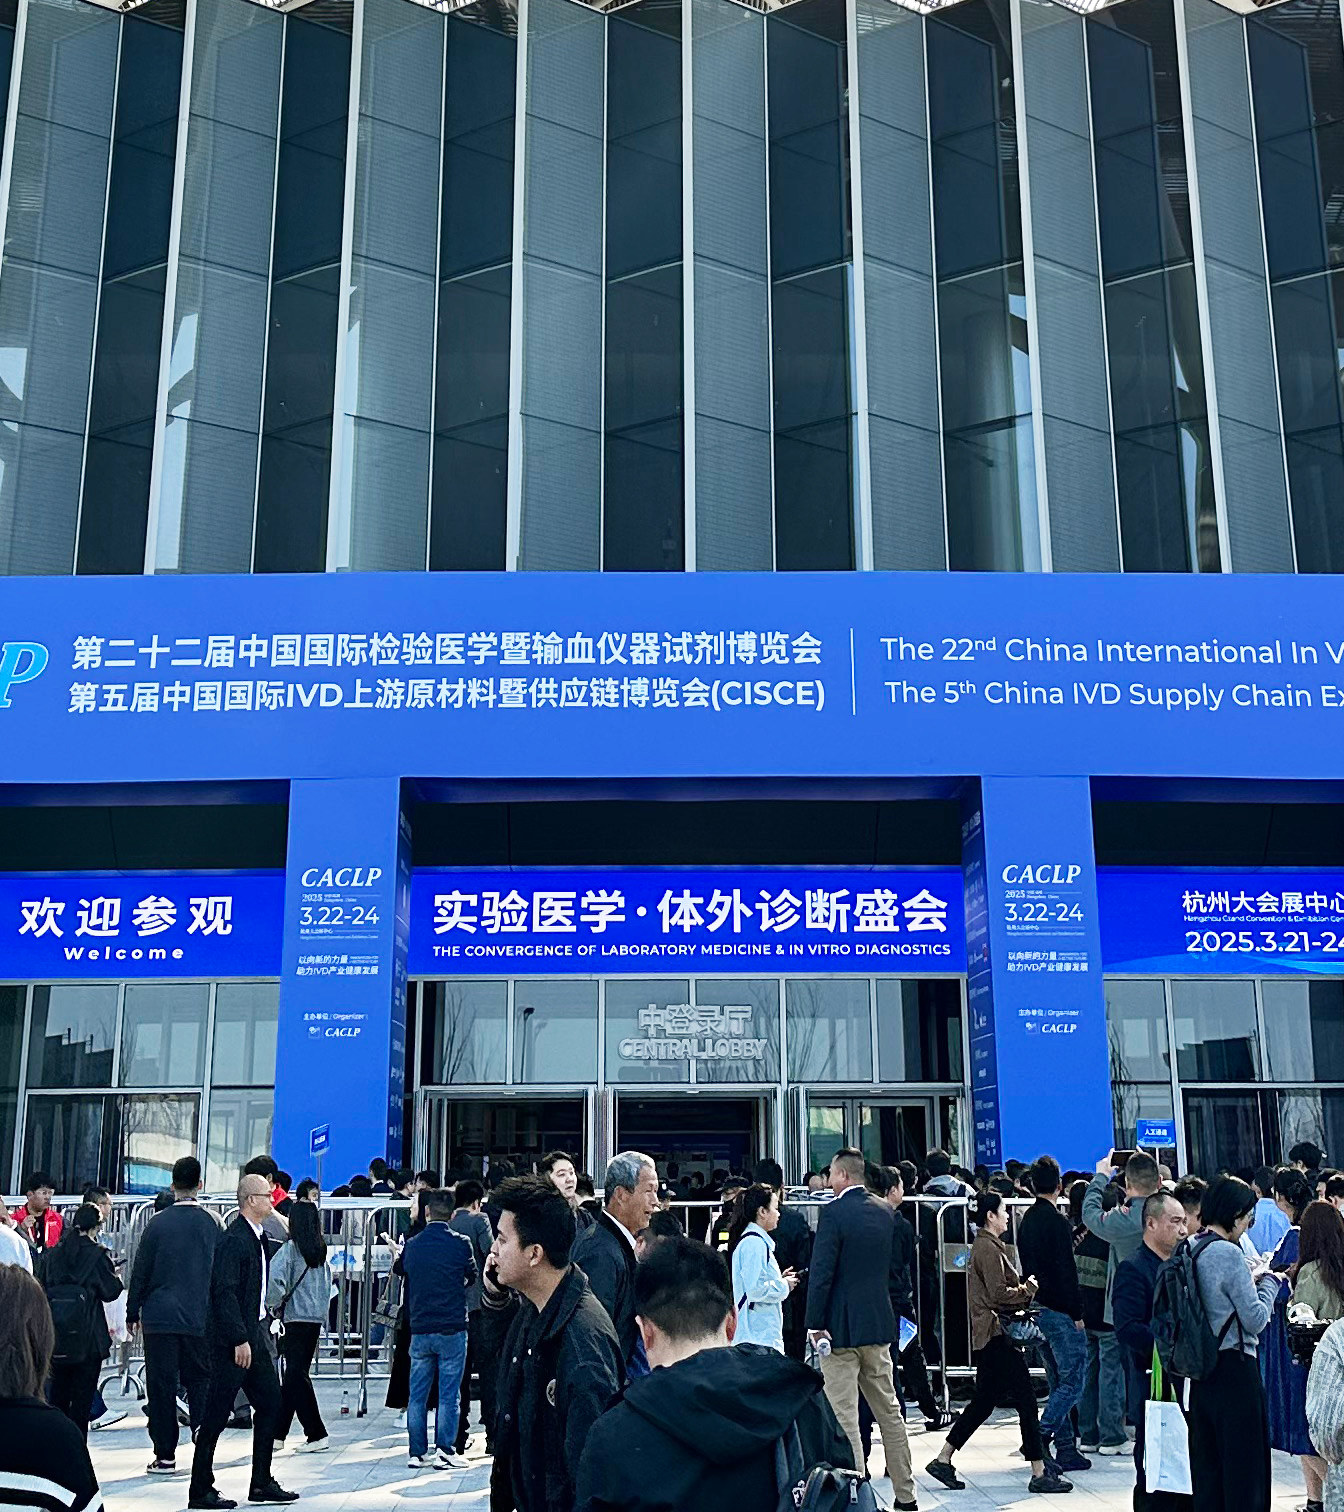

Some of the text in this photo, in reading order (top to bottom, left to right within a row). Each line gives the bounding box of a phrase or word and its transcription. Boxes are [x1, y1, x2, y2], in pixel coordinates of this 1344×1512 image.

[72, 631, 822, 671] 第二十二届中国国际检验医学暨输血仪器试剂博览会
[880, 637, 934, 661] The
[941, 636, 997, 662] 22nd
[1005, 638, 1088, 662] China
[1097, 639, 1281, 664] International
[1291, 640, 1318, 664] In
[67, 677, 826, 714] 第五届中国国际IVD上游原材料暨供应链博览会(CISCE)
[885, 681, 936, 703] The
[943, 680, 977, 704] 5th
[984, 681, 1064, 705] China
[1073, 683, 1121, 705] IVD
[1129, 683, 1224, 712] Supply
[1232, 684, 1312, 707] Chain
[301, 867, 383, 888] CACLP
[1002, 864, 1082, 884] CACLP
[18, 894, 234, 938] 欢迎参观
[300, 906, 380, 926] 3.22-24
[433, 888, 949, 935] 实验医学·体外诊断盛会
[1004, 903, 1084, 922] 3.22-24
[63, 946, 184, 961] Welcome
[433, 944, 951, 957] THE CONVERGENCE OF LABORATORY MEDICINE & IN VITRO DIAGNOSTICS
[638, 1004, 752, 1037] 中登录厅
[1041, 1023, 1077, 1033] CACLP
[325, 1027, 361, 1038] CACLP
[618, 1038, 768, 1060] CENTRAL LOBBY
